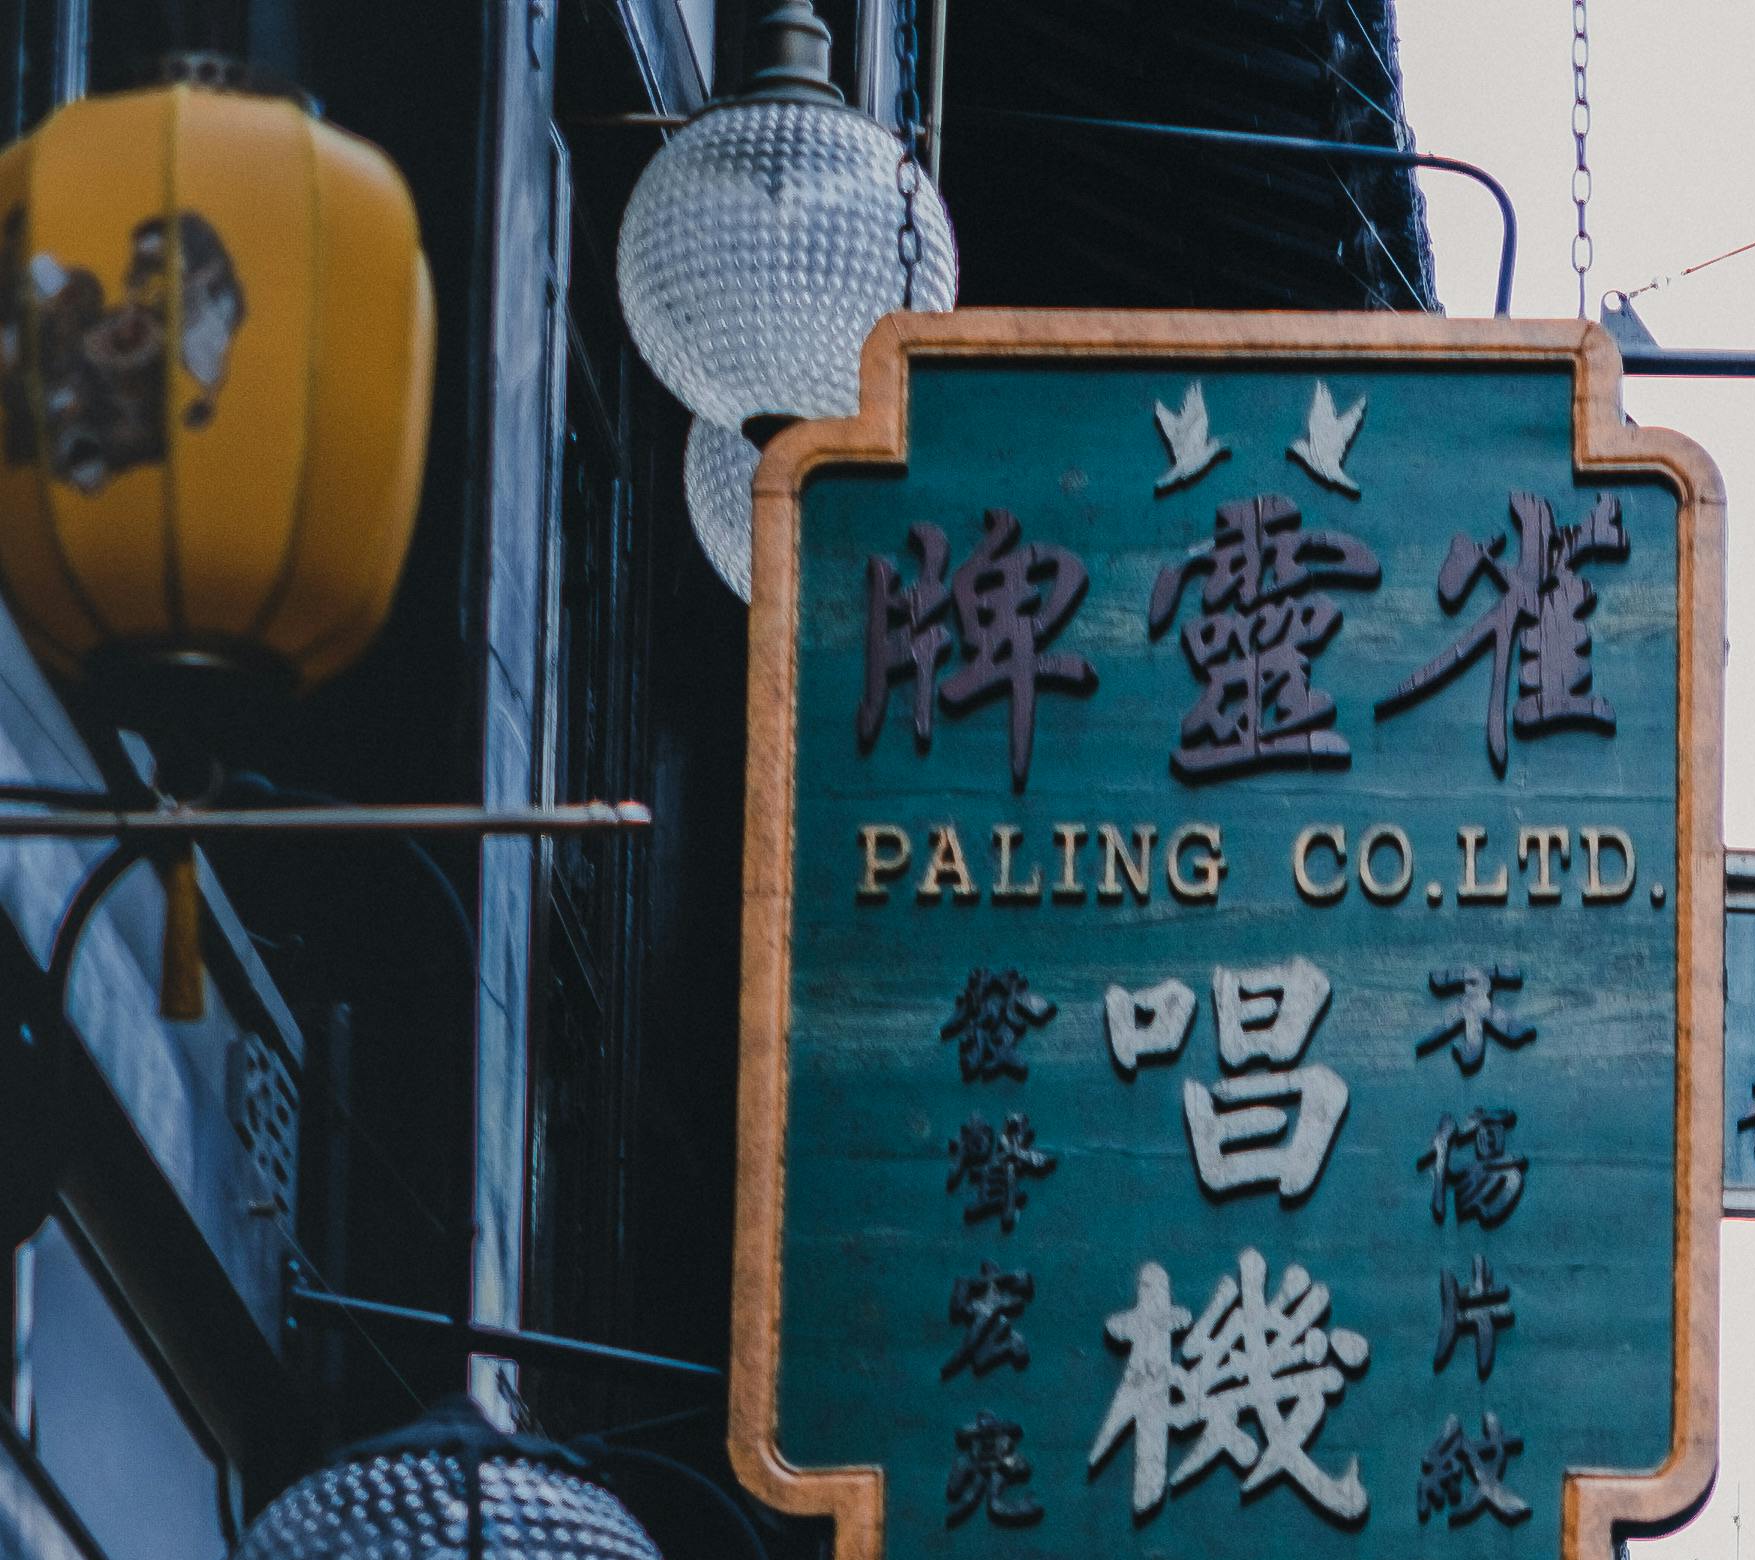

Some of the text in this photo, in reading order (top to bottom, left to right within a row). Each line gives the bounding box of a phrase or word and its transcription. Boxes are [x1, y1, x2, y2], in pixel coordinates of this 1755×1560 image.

[855, 822, 1668, 908] PALING CO.LTD.
[1086, 955, 1374, 1528] 唱機
[1414, 962, 1540, 1526] 不傷片紋
